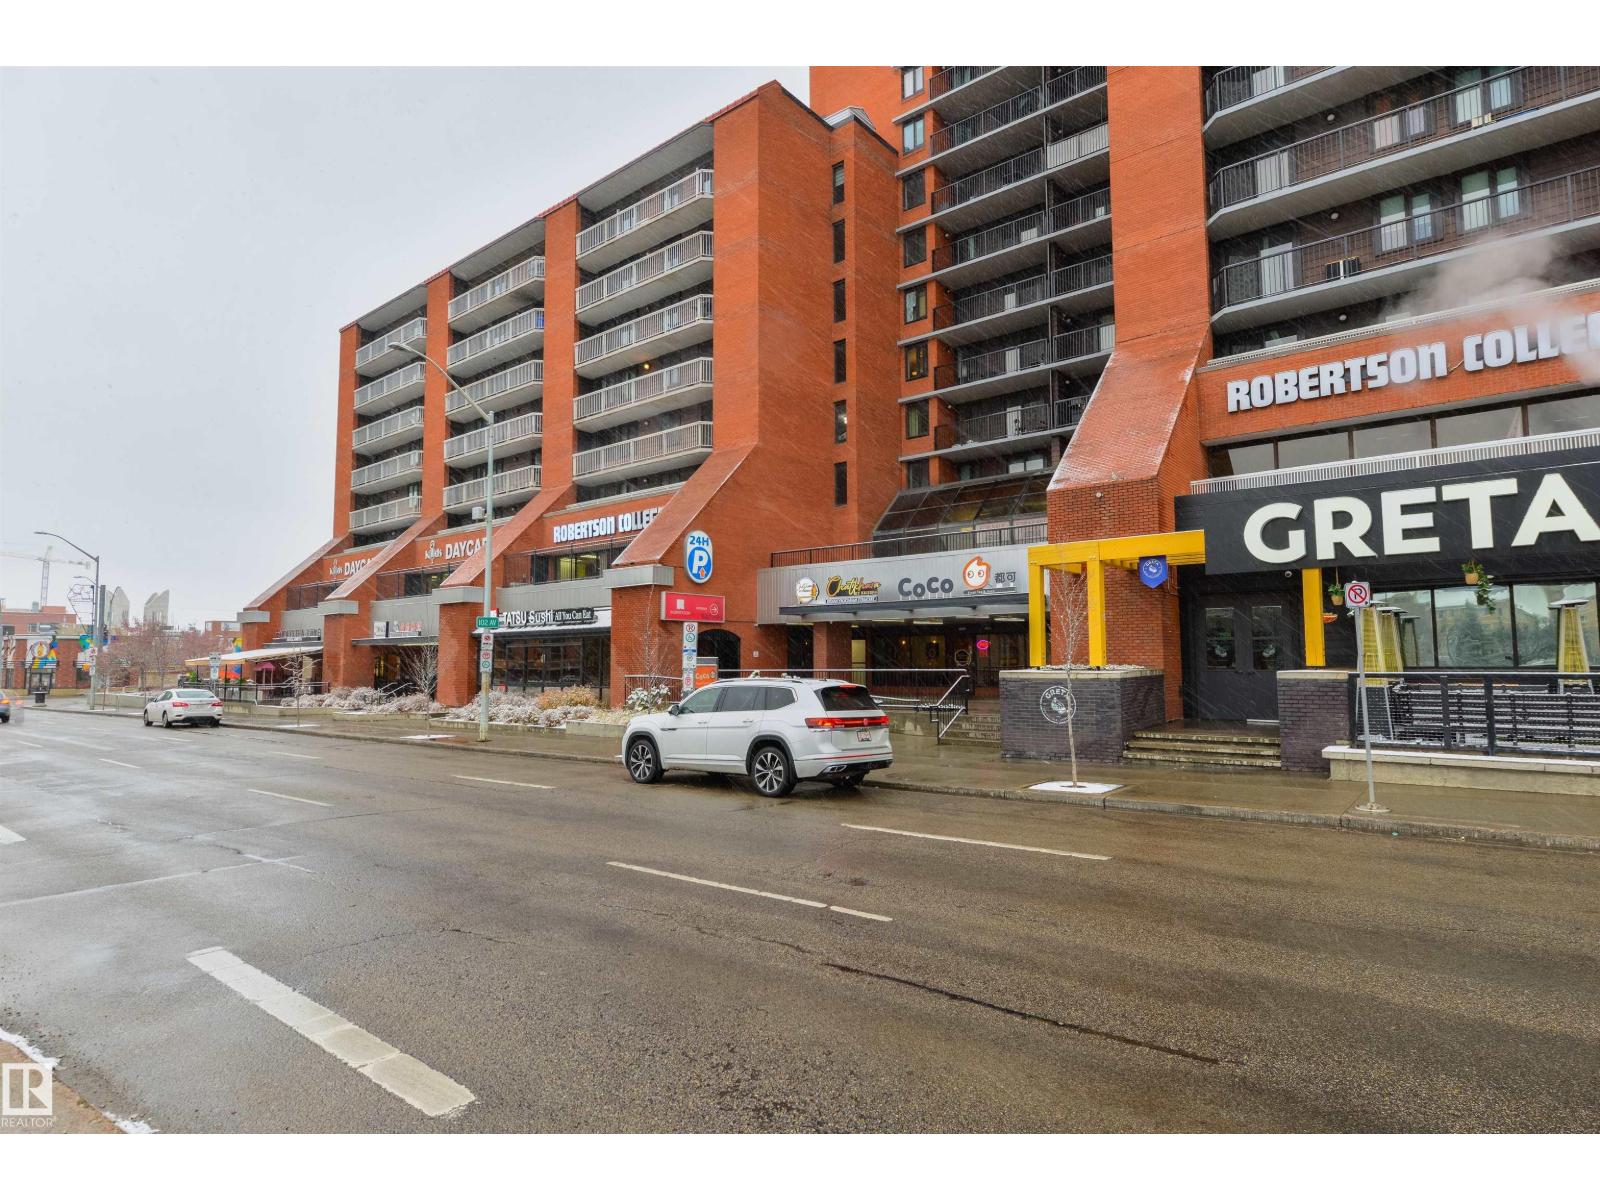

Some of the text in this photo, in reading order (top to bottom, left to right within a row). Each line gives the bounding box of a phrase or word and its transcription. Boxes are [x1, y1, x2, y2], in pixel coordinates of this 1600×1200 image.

[1227, 341, 1447, 412] ROBERTSON
[1244, 473, 1600, 563] GRETA
[553, 516, 615, 543] ROBERTSON
[689, 535, 709, 546] 24H
[692, 550, 708, 573] P
[898, 577, 954, 598] CoCo
[995, 571, 1016, 583] 都可
[503, 610, 527, 625] TATSU
[529, 609, 554, 624] Sushi
[562, 611, 571, 620] You
[572, 610, 582, 619] Can
[583, 609, 591, 619] Eat
